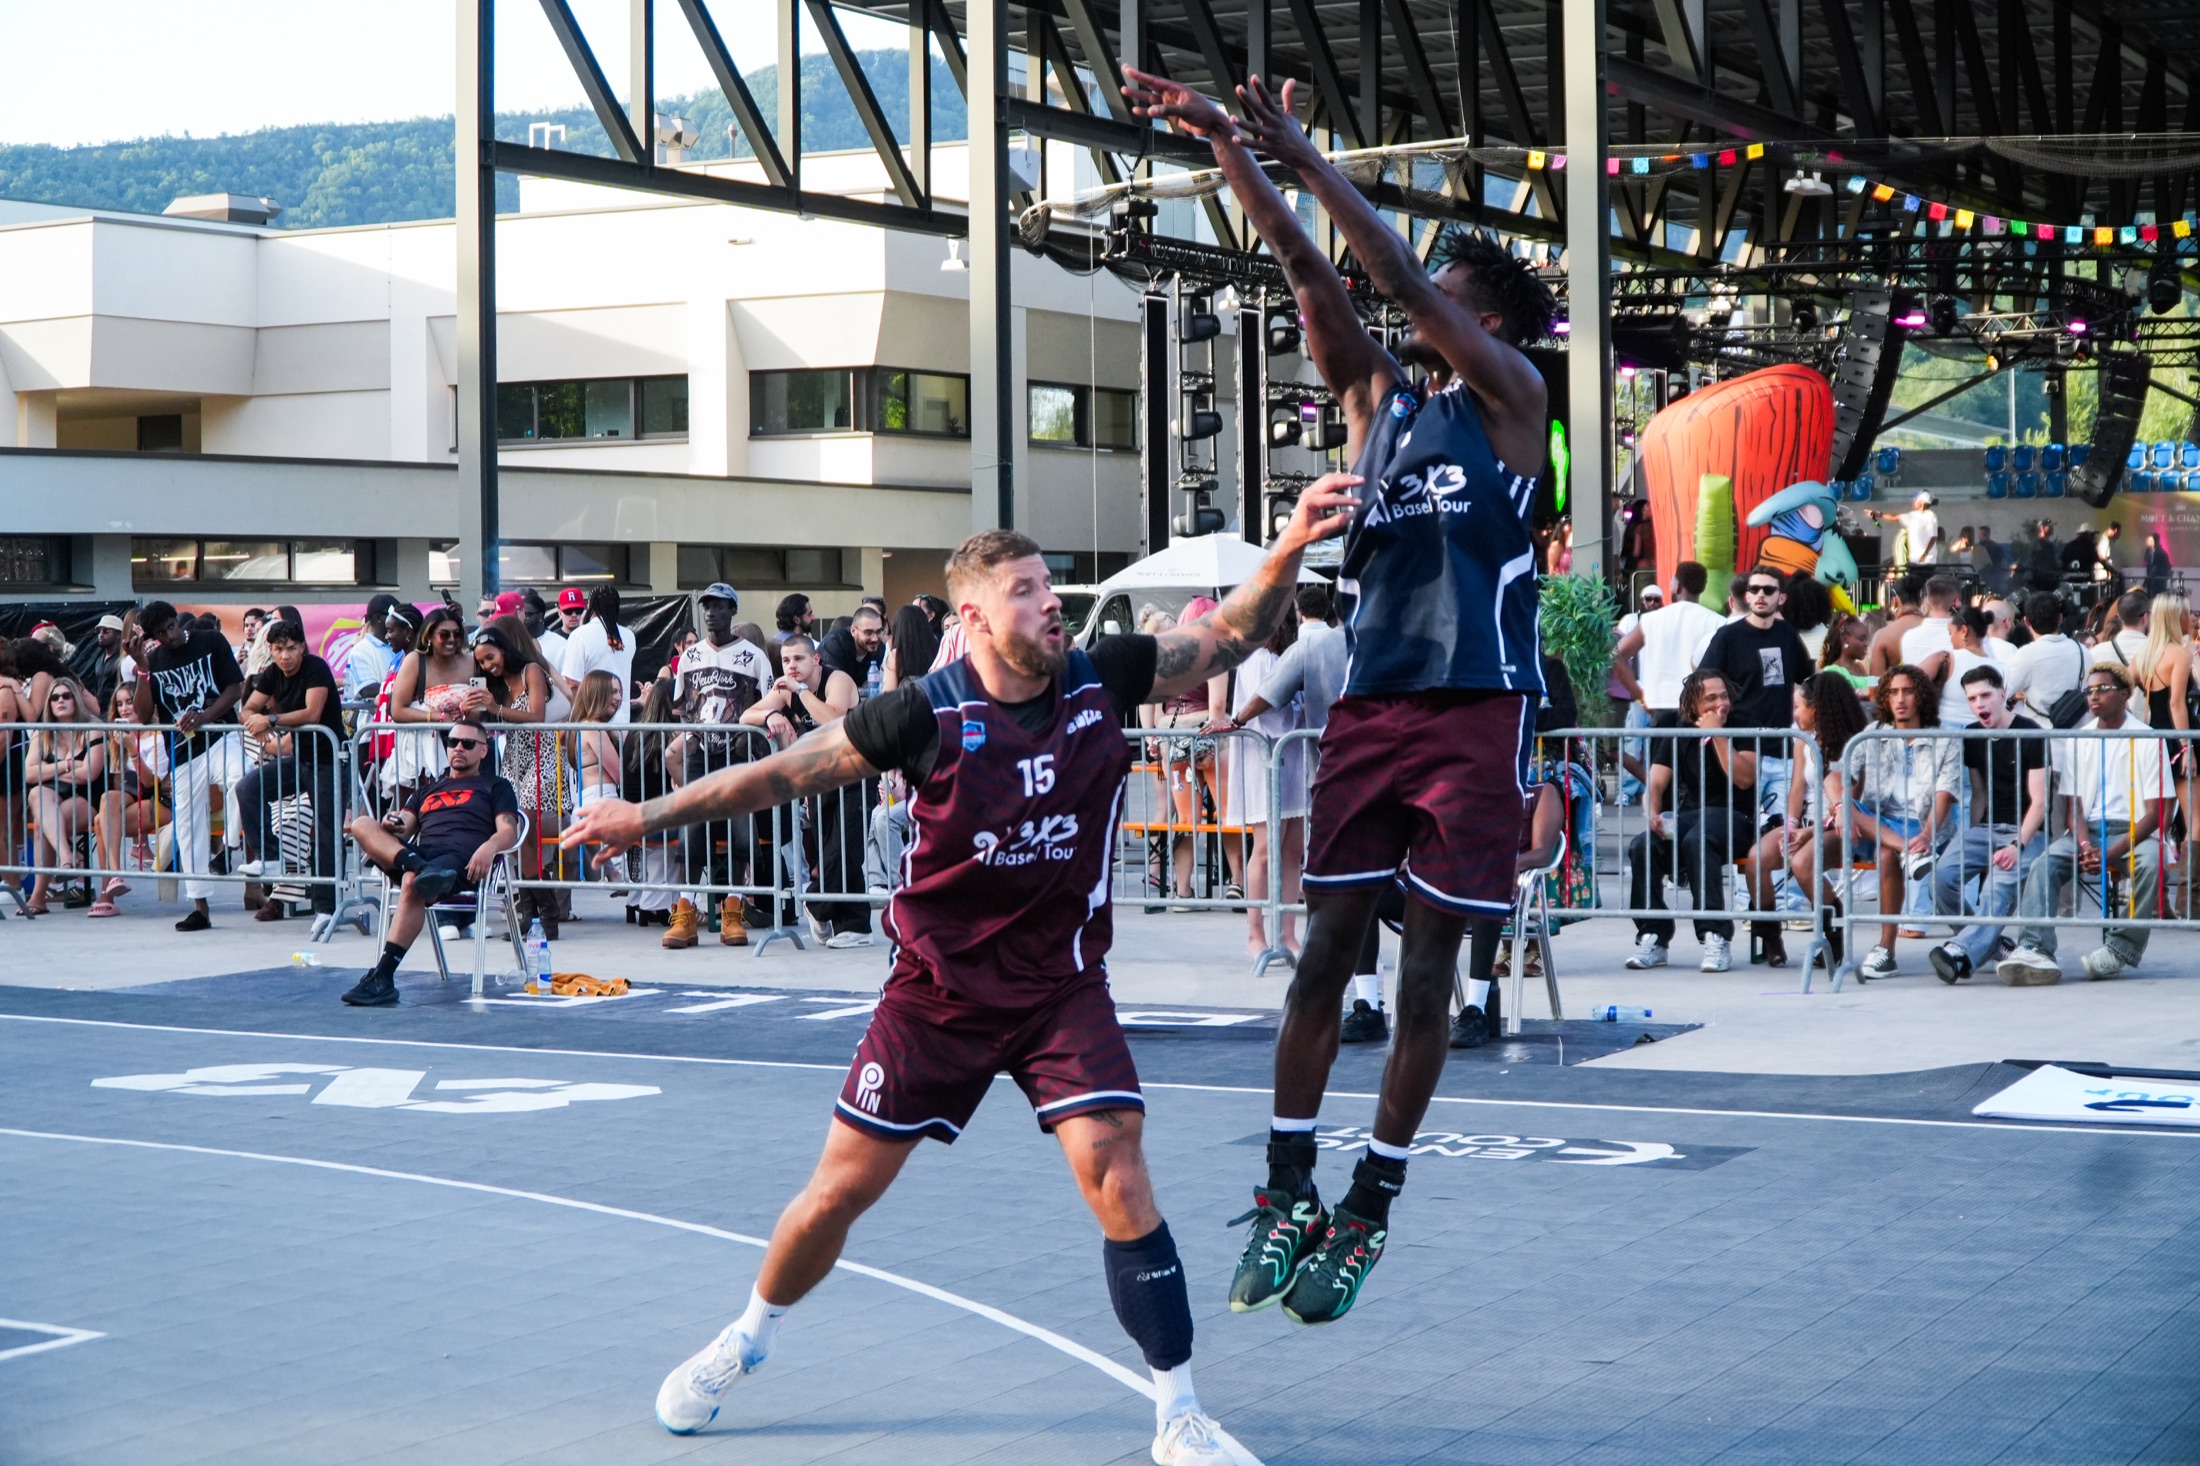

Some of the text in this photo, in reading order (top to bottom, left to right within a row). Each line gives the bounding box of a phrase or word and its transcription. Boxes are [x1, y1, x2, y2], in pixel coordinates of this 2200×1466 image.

[1392, 496, 1471, 519] Basel Tour
[1016, 753, 1056, 797] 15
[855, 1061, 885, 1114] PIN
[1316, 1126, 1566, 1148] COUT
